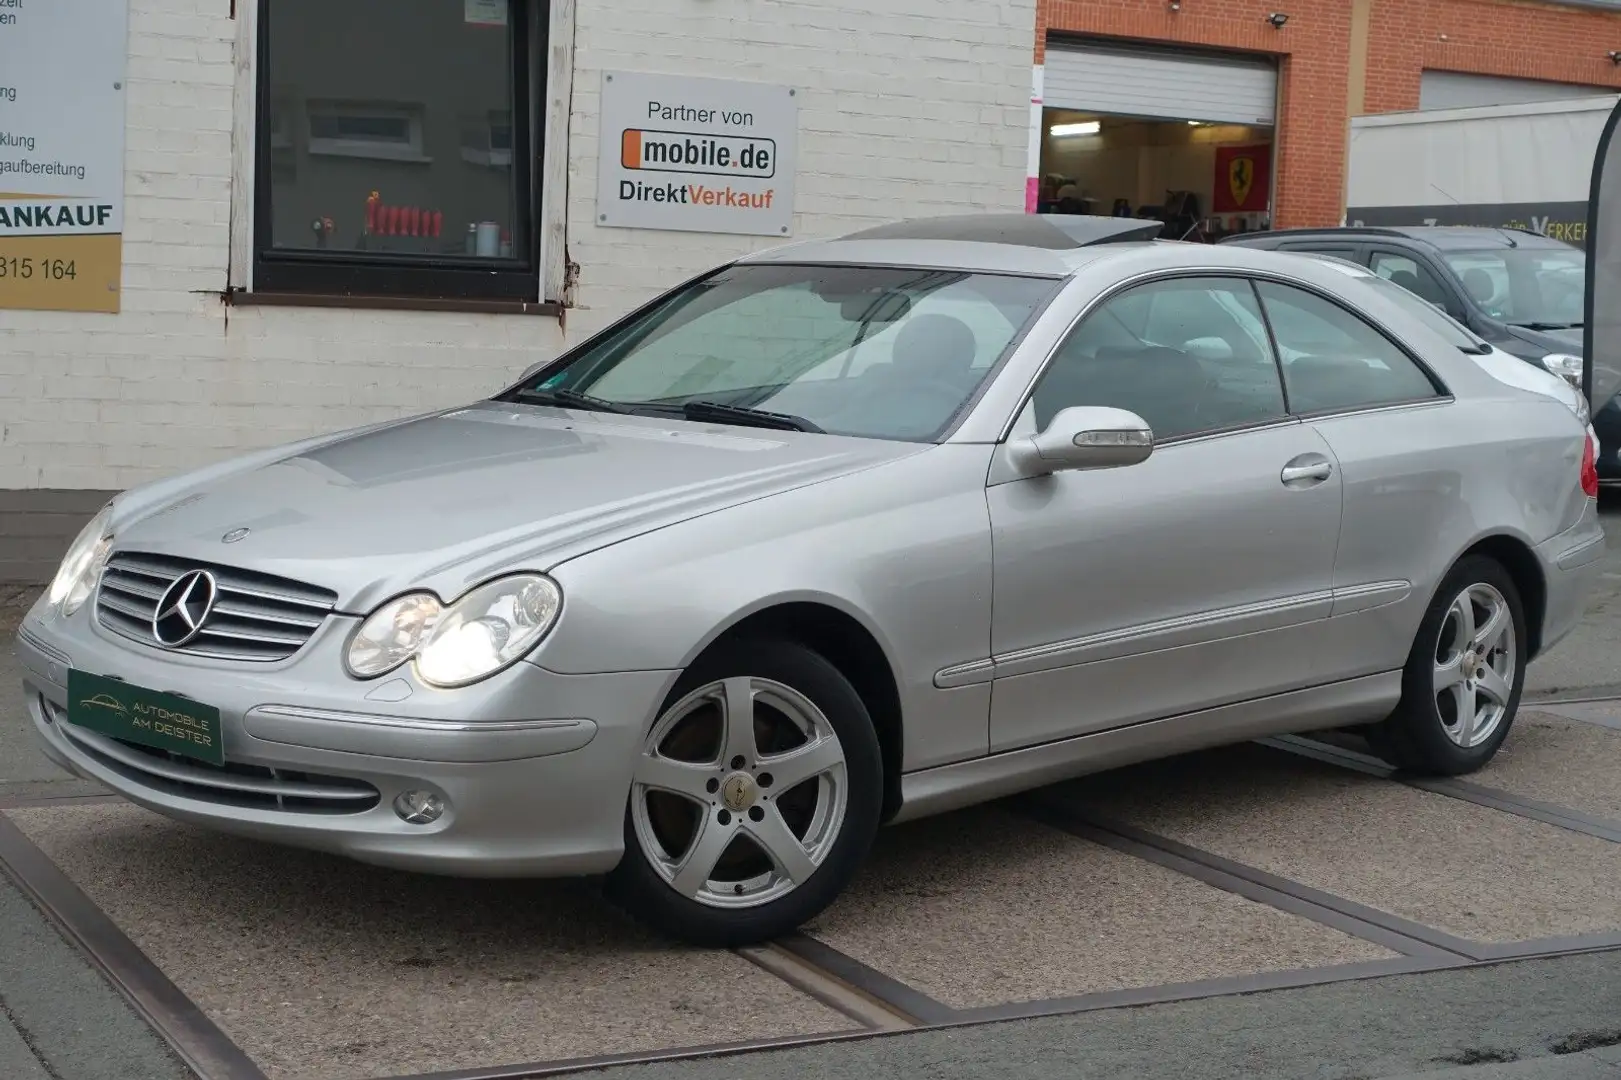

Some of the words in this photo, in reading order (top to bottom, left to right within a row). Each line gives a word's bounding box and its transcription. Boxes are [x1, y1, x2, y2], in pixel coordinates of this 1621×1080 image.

[648, 101, 717, 123] Partner
[722, 111, 754, 126] von
[644, 138, 770, 170] mobile.de
[619, 179, 774, 209] DirektVerkauf
[0, 204, 113, 228] ANKAUF
[41, 257, 77, 280] 164
[132, 716, 151, 730] AM
[154, 721, 212, 748] DEISTER
[133, 702, 210, 732] AUTOMOBILE
